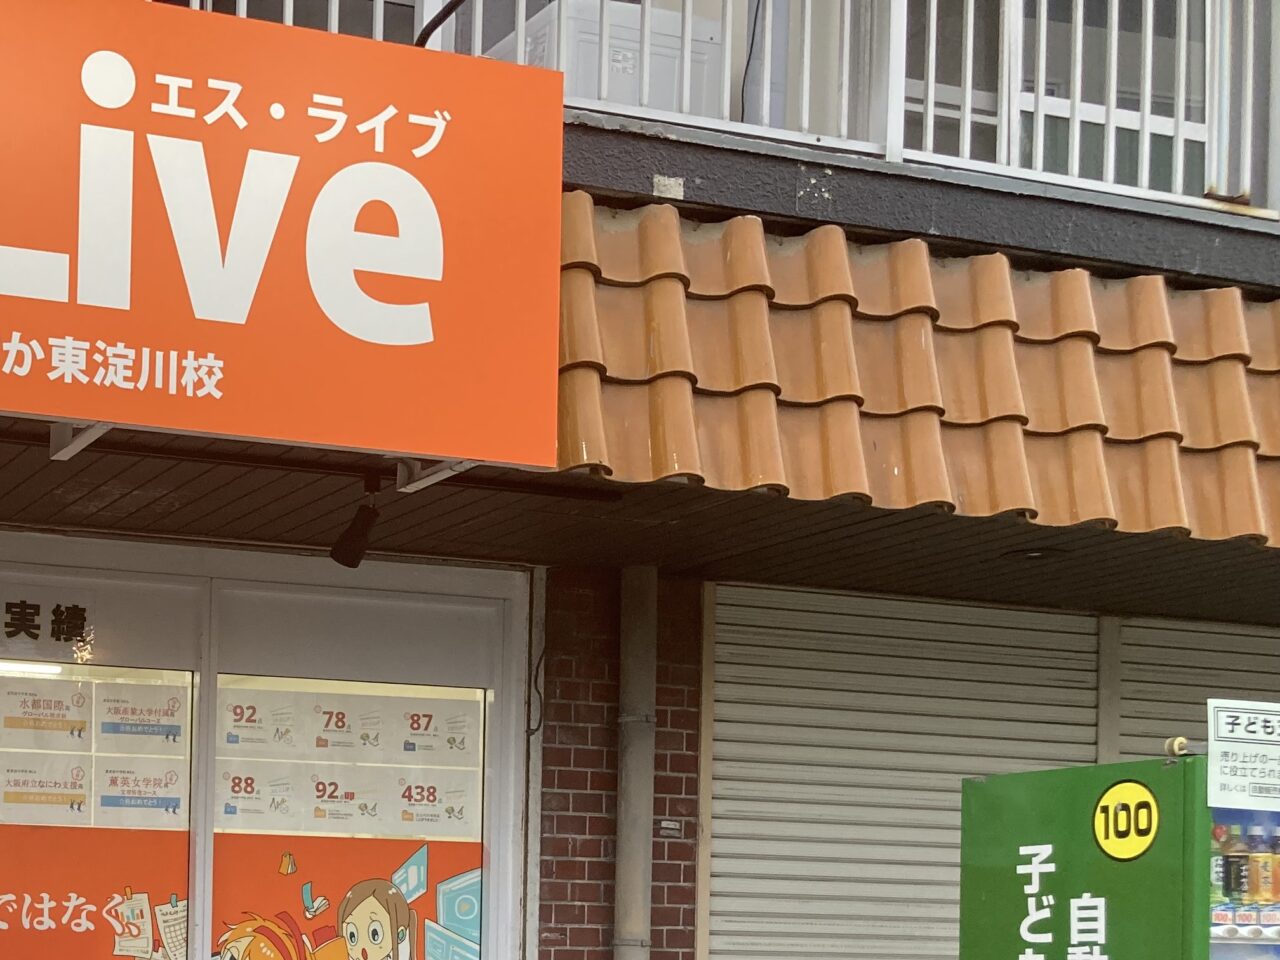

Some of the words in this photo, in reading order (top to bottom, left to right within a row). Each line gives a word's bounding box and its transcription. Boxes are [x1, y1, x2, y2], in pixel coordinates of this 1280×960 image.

[151, 74, 451, 158] エス・ライブ
[1225, 715, 1280, 736] 子ども
[1098, 799, 1153, 843] 100
